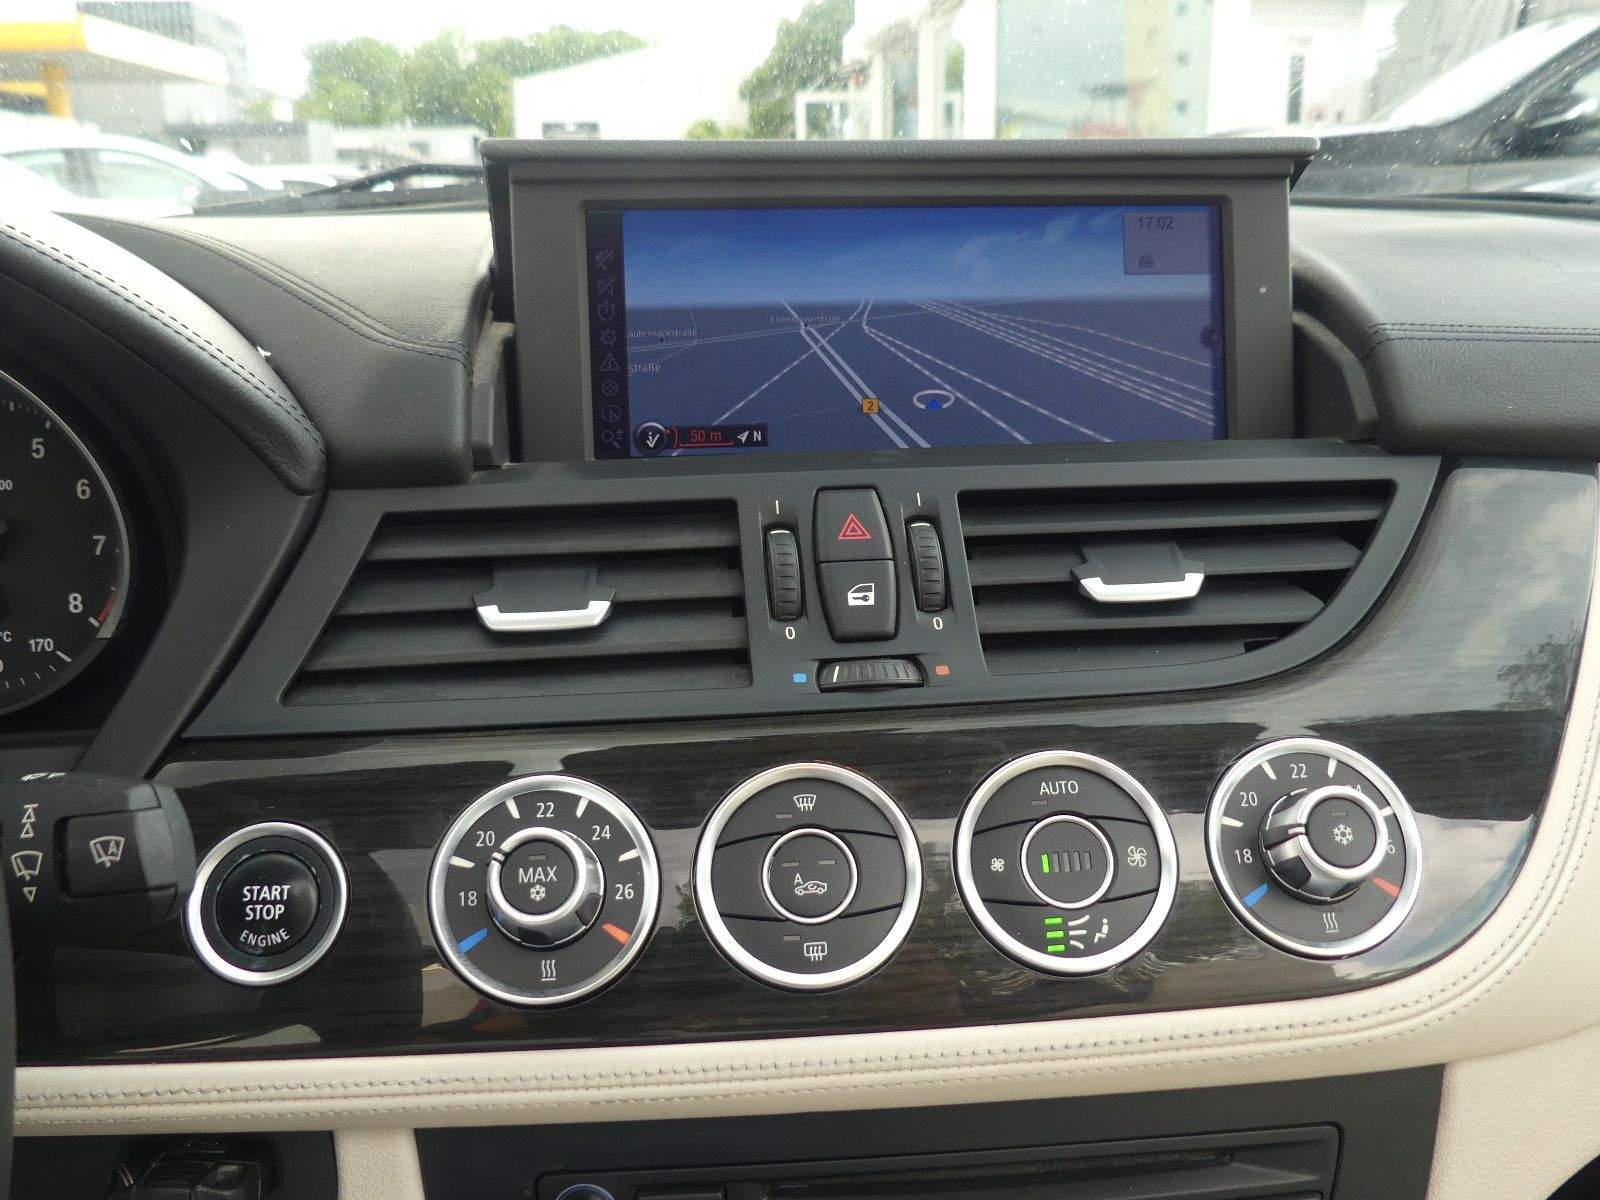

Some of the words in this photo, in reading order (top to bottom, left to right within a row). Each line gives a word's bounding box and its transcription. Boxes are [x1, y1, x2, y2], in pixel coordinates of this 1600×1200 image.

[1137, 216, 1175, 230] 17:02
[690, 429, 706, 442] 50
[709, 431, 723, 442] m
[753, 429, 763, 443] N
[30, 437, 46, 459] 5
[75, 479, 92, 501] 6
[92, 534, 107, 556] 7
[68, 592, 84, 614] 8
[29, 638, 54, 652] 170
[1289, 763, 1308, 779] 22
[1039, 780, 1079, 796] AUTO
[1239, 791, 1258, 807] 20
[536, 802, 556, 819] 22
[475, 830, 496, 847] 20
[591, 824, 611, 841] 24
[1234, 849, 1253, 864] 18
[518, 865, 558, 884] MAX
[242, 885, 291, 901] START
[459, 890, 478, 908] 18
[615, 883, 635, 901] 26
[245, 904, 285, 921] STOP
[239, 927, 290, 947] ENGINE
